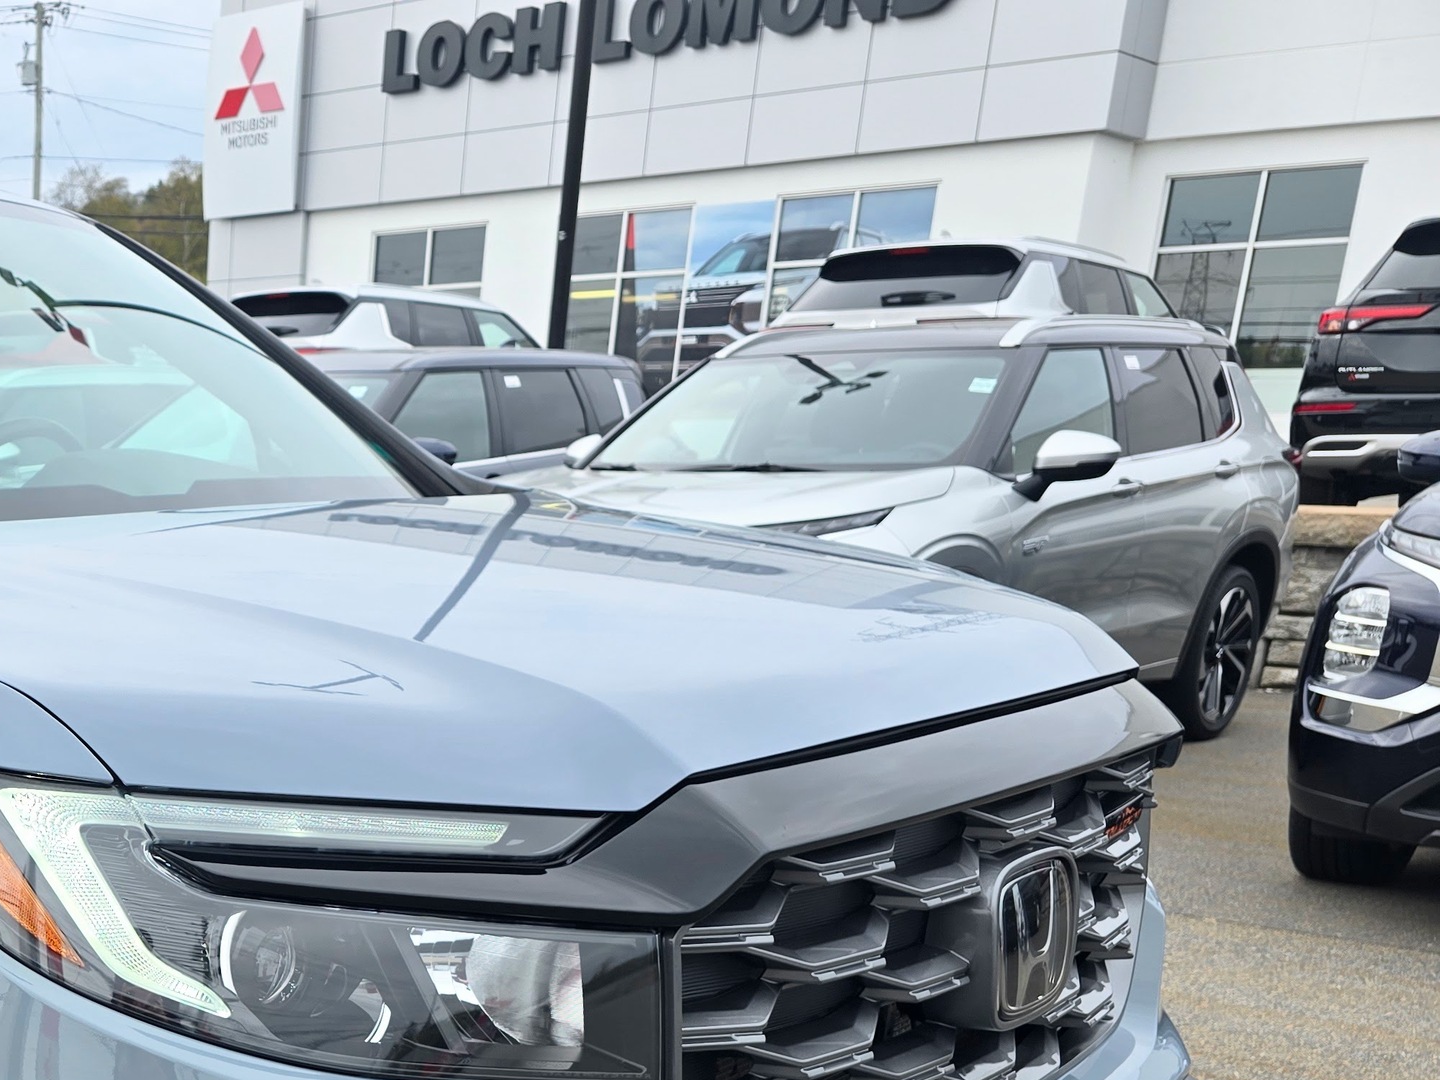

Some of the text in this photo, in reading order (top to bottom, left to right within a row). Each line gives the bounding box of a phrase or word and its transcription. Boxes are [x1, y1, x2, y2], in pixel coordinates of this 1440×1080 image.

[382, 1, 567, 94] LOCH
[220, 115, 277, 135] MITSUBISHI
[227, 132, 269, 150] MOTORS
